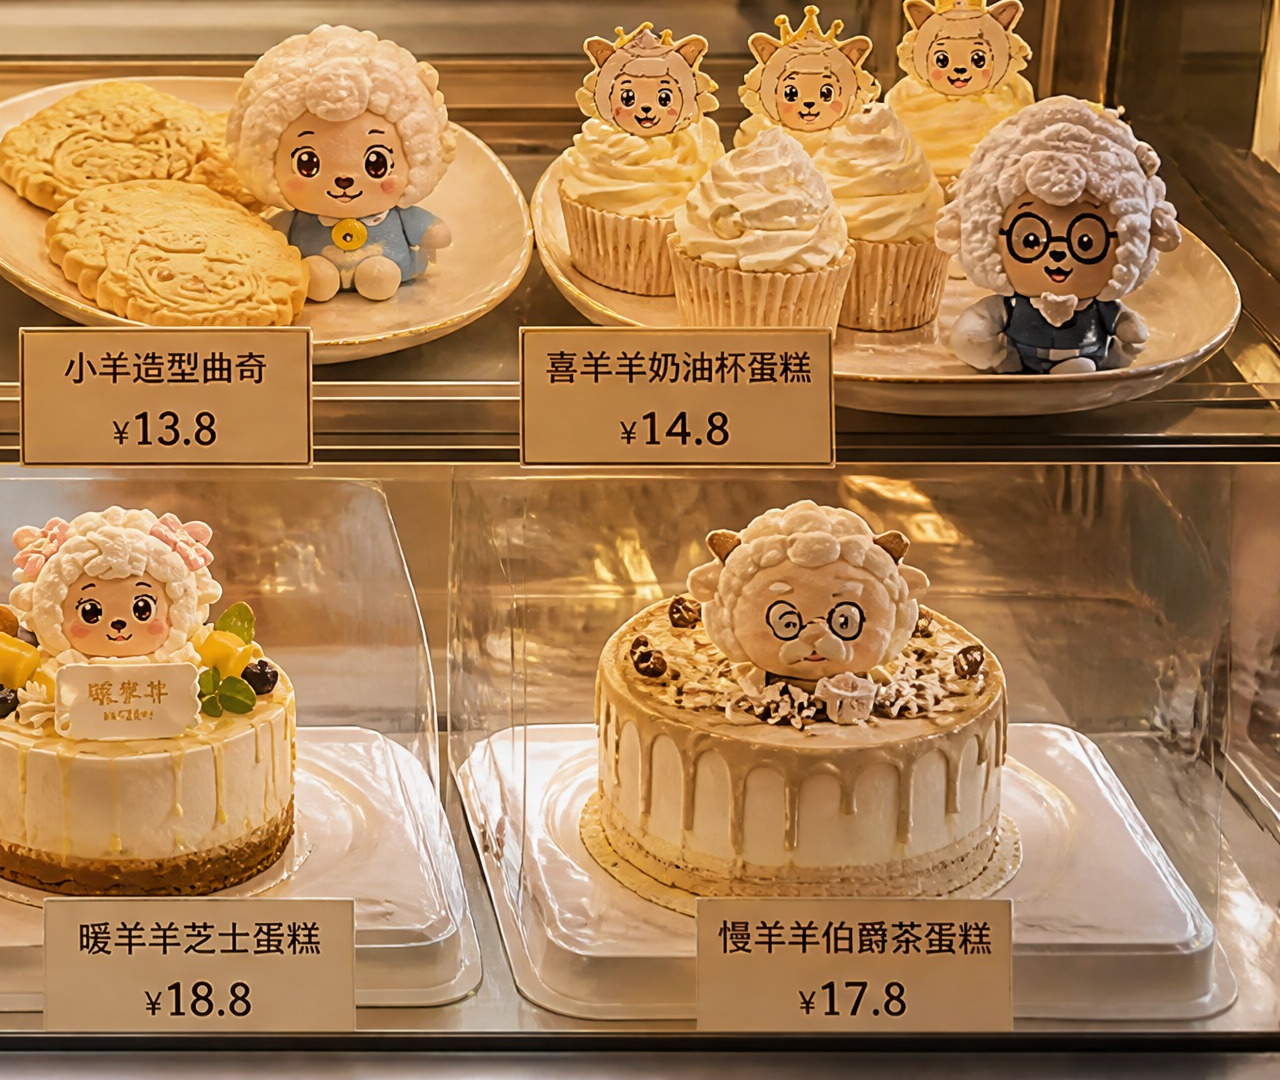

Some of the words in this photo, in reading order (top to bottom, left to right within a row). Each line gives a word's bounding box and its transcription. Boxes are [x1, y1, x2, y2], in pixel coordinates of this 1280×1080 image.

[64, 351, 267, 385] 小羊造型曲奇
[546, 350, 812, 384] 喜羊羊奶油杯蛋糕
[112, 410, 217, 446] ¥13.8
[619, 411, 730, 446] ¥14.8
[79, 921, 321, 956] 暖羊羊芝士蛋糕
[718, 919, 992, 956] 慢羊羊伯爵茶蛋糕
[144, 980, 252, 1017] ¥18.8
[798, 980, 907, 1017] ¥17.8
